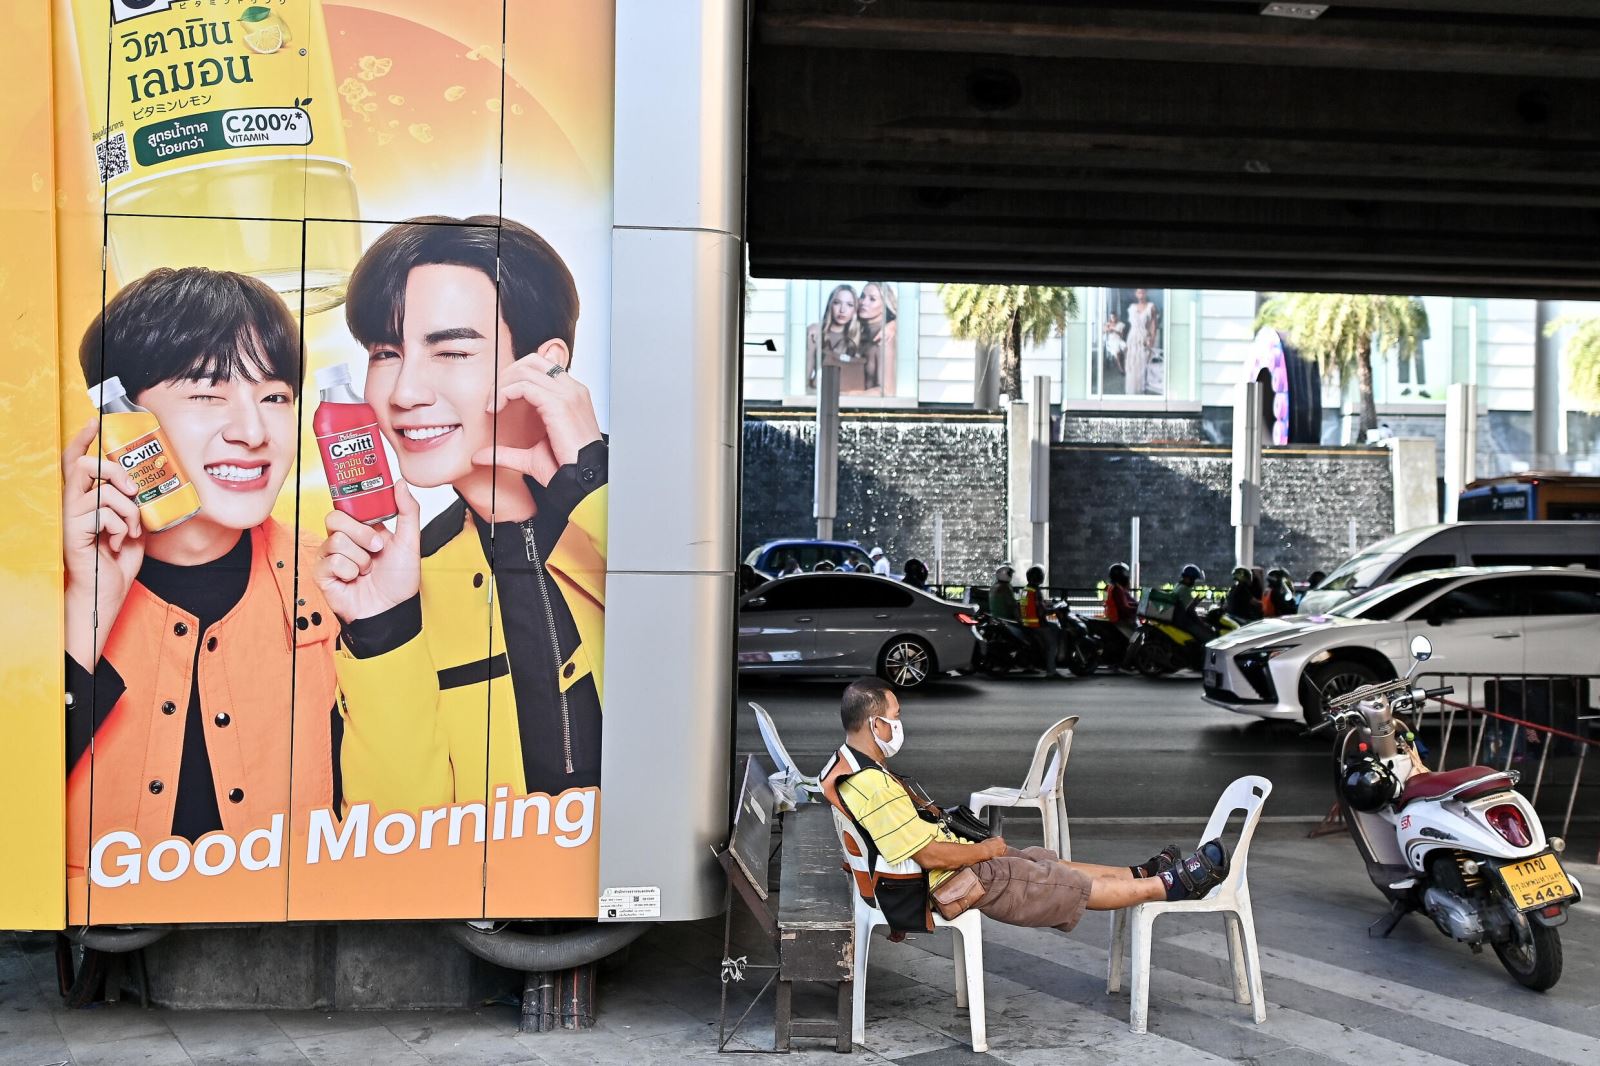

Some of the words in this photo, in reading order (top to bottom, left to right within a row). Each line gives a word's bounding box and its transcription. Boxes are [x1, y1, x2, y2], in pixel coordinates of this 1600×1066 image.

[120, 17, 233, 63] วิตามิน
[127, 55, 254, 104] เลมอน
[133, 94, 212, 121] ビタミンレモン
[147, 121, 208, 147] สูตรน้ำตาล
[228, 133, 270, 144] VITAMIN
[156, 137, 205, 158] น้อยกว่า
[121, 442, 161, 468] C-vitt
[331, 437, 373, 458] C-vitt
[90, 813, 284, 888] Good
[306, 786, 596, 864] Morning
